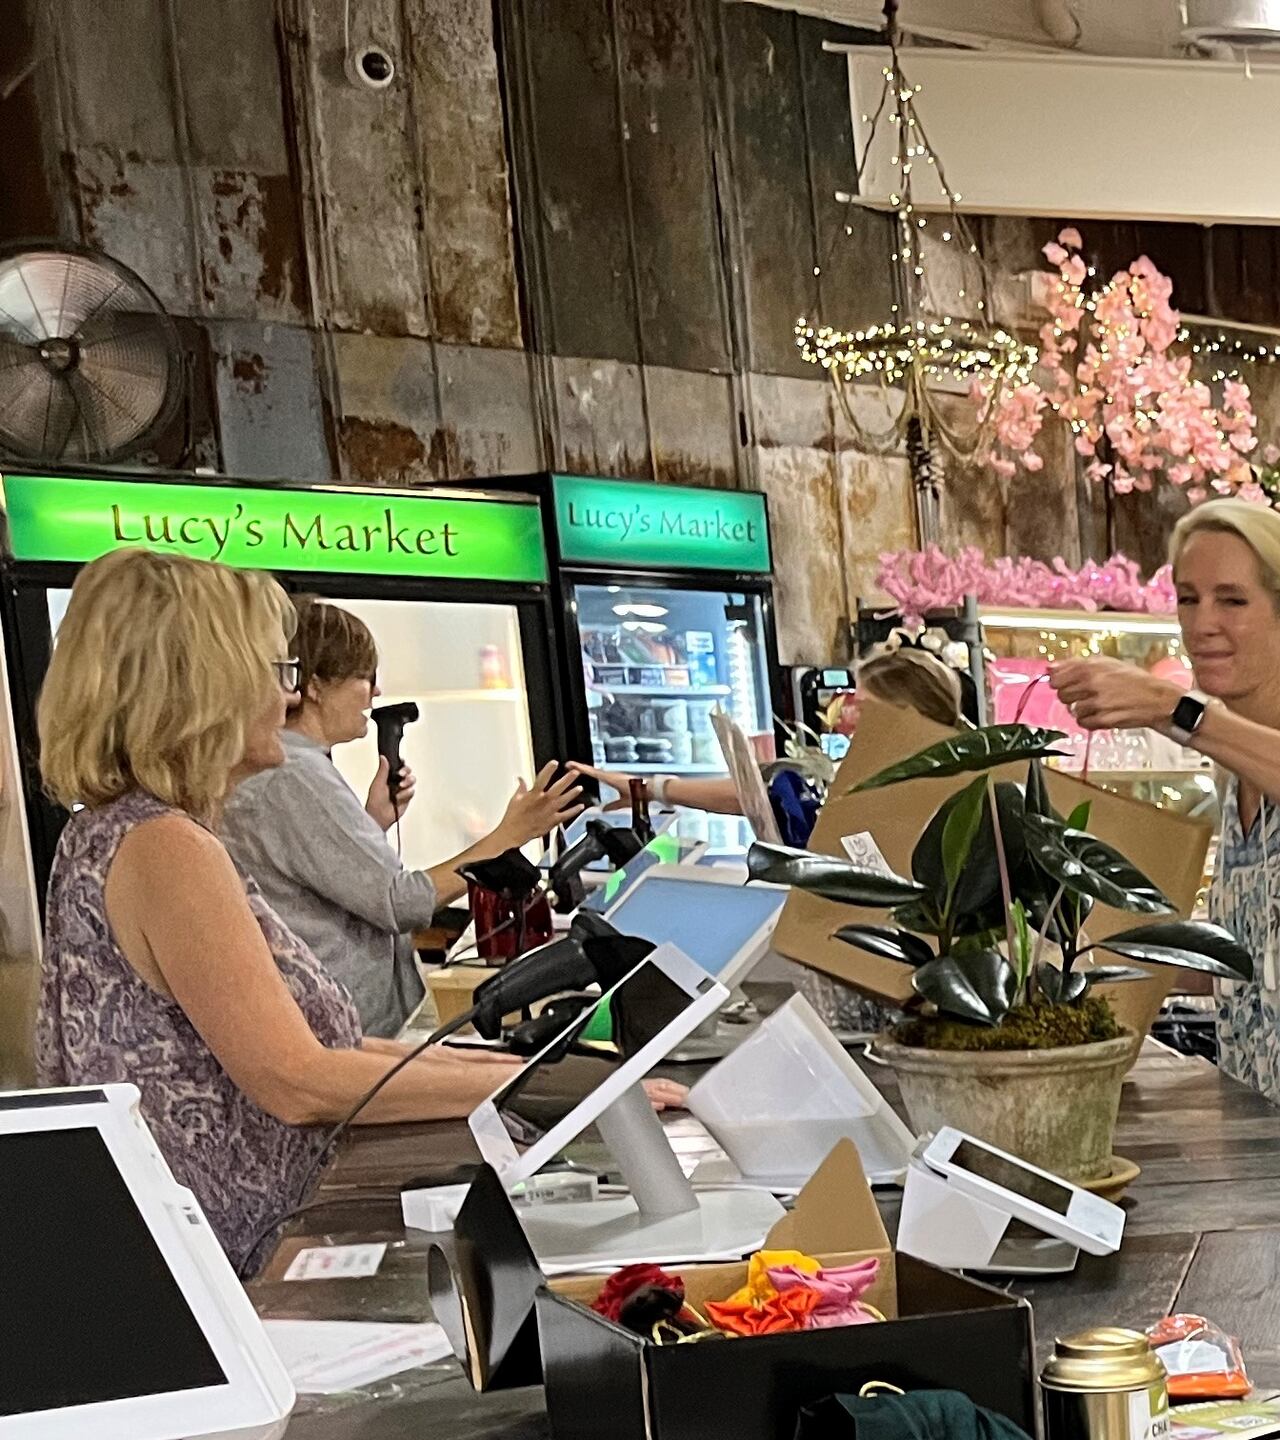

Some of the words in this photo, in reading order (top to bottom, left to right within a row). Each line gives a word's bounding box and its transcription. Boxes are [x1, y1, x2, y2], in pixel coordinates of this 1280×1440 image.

[111, 503, 265, 561] Lucy's
[283, 508, 460, 557] Market
[568, 502, 651, 541] Lucy's
[659, 510, 757, 542] Market
